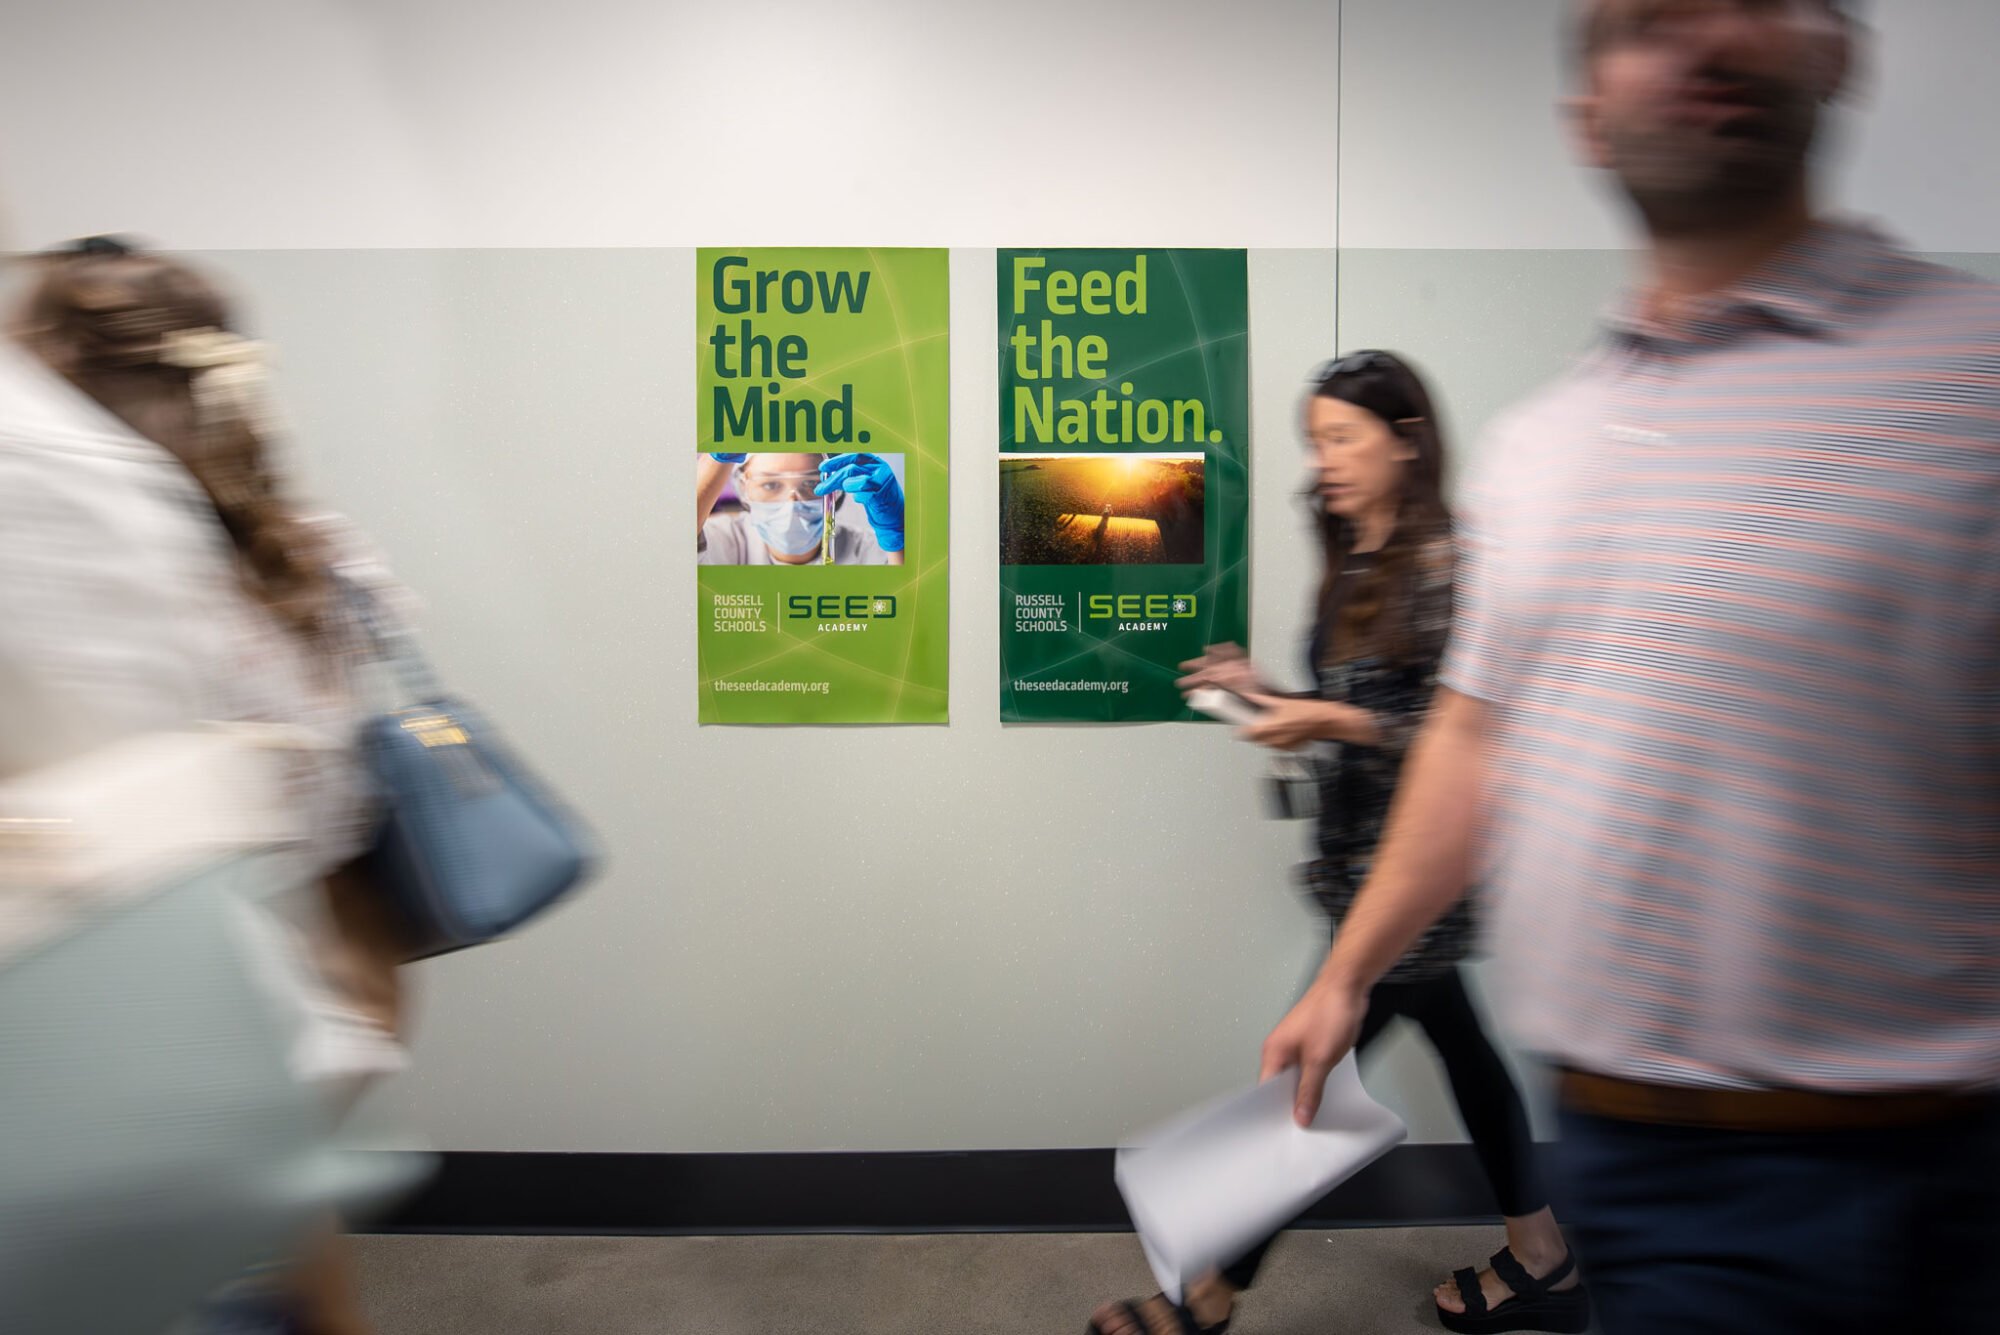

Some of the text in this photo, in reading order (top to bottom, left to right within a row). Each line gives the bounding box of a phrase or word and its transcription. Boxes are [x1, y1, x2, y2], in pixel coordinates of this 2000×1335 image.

[712, 256, 871, 315] Grow
[1013, 254, 1147, 315] Feed
[710, 319, 808, 379] the
[1011, 319, 1108, 379] the
[713, 383, 871, 443] Mind.
[1014, 382, 1222, 444] Nation.
[714, 595, 764, 606] RUSSELL
[788, 595, 897, 619] SEED
[1015, 595, 1065, 606] RUSSELL
[1089, 595, 1197, 619] SEED
[714, 608, 762, 619] COUNTY
[1015, 608, 1063, 619] COUNTY
[714, 621, 766, 632] SCHOOLS
[817, 623, 868, 632] ACADEMY
[1015, 621, 1067, 632] SCHOOLS
[1118, 622, 1168, 631] ACADEMY
[714, 679, 829, 694] theseedacademy.org
[1014, 679, 1129, 693] theseedacademy.org
